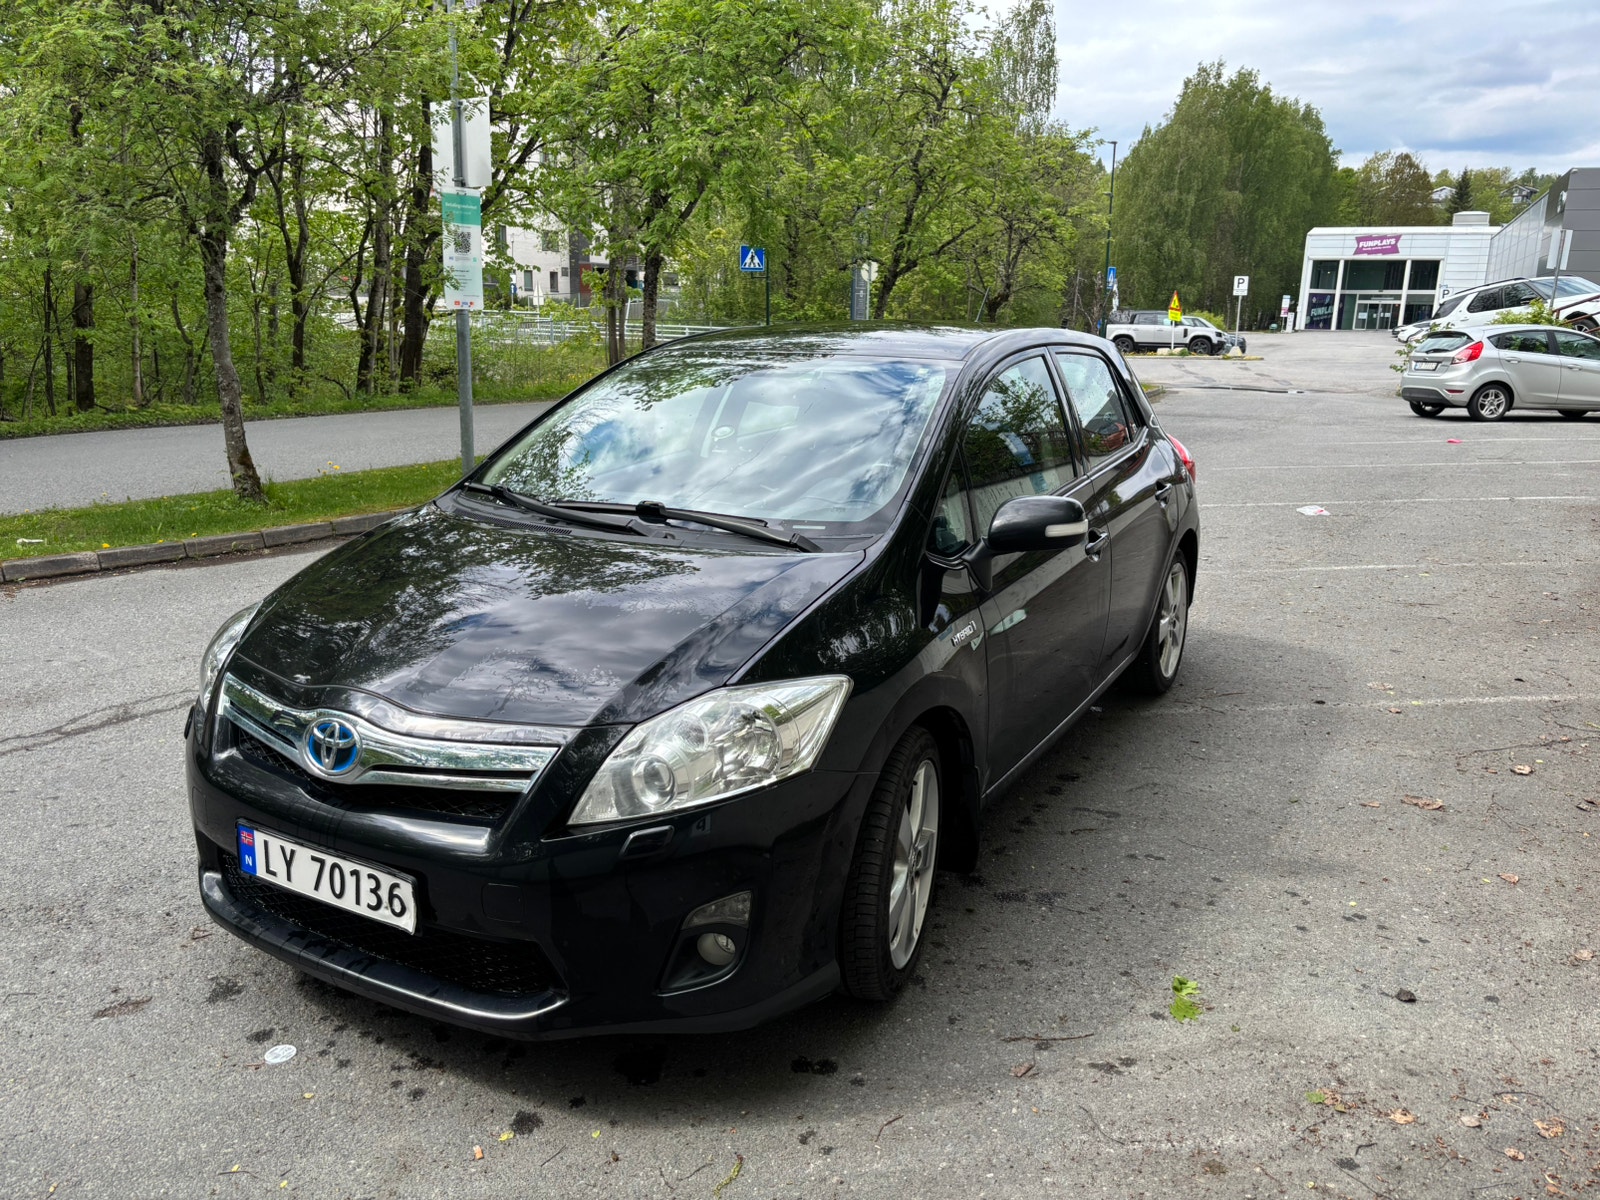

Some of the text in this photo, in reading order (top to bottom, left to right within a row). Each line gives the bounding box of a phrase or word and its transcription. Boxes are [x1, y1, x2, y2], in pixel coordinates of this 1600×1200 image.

[1359, 238, 1396, 248] FUNPLAYS
[1237, 278, 1245, 288] P
[1442, 289, 1450, 299] P
[952, 625, 974, 646] HYBRID
[245, 853, 252, 867] N
[263, 839, 407, 918] LY 70136
